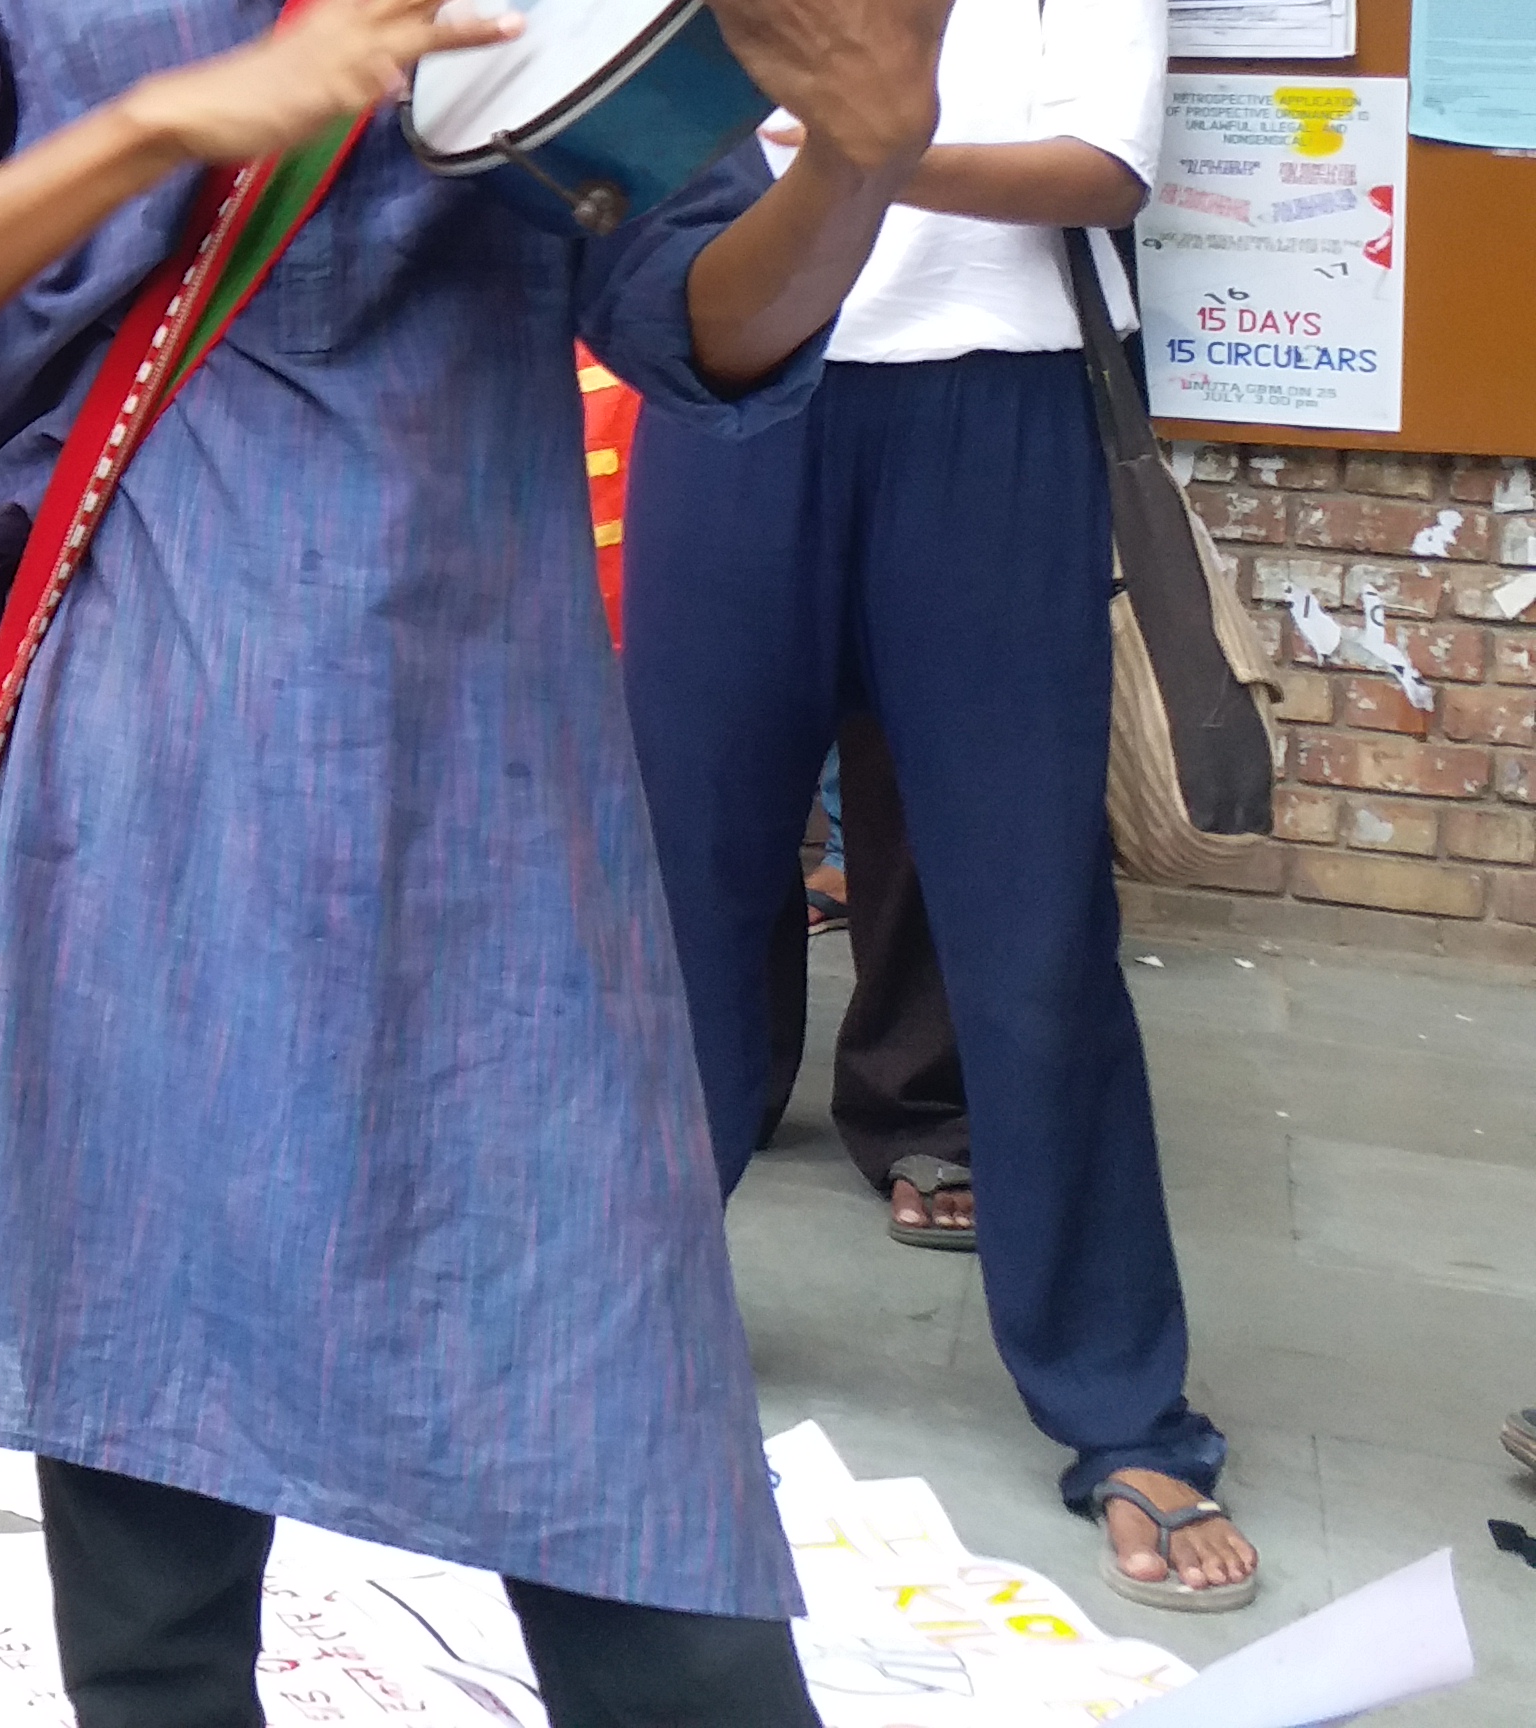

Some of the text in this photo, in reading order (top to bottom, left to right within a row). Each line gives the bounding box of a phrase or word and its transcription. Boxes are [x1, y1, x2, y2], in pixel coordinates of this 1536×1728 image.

[1172, 92, 1362, 108] RETROSPECTIVE APPLICATION
[1166, 105, 1180, 118] OF
[1185, 105, 1270, 119] PROSPECTIVE
[1356, 111, 1370, 121] IS
[1322, 122, 1348, 133] AND
[1195, 306, 1322, 336] 15 DAYS
[1165, 338, 1378, 374] 15 CIRCULARS
[1246, 384, 1283, 397] GBM
[1287, 385, 1312, 398] ON
[1294, 398, 1319, 410] pm
